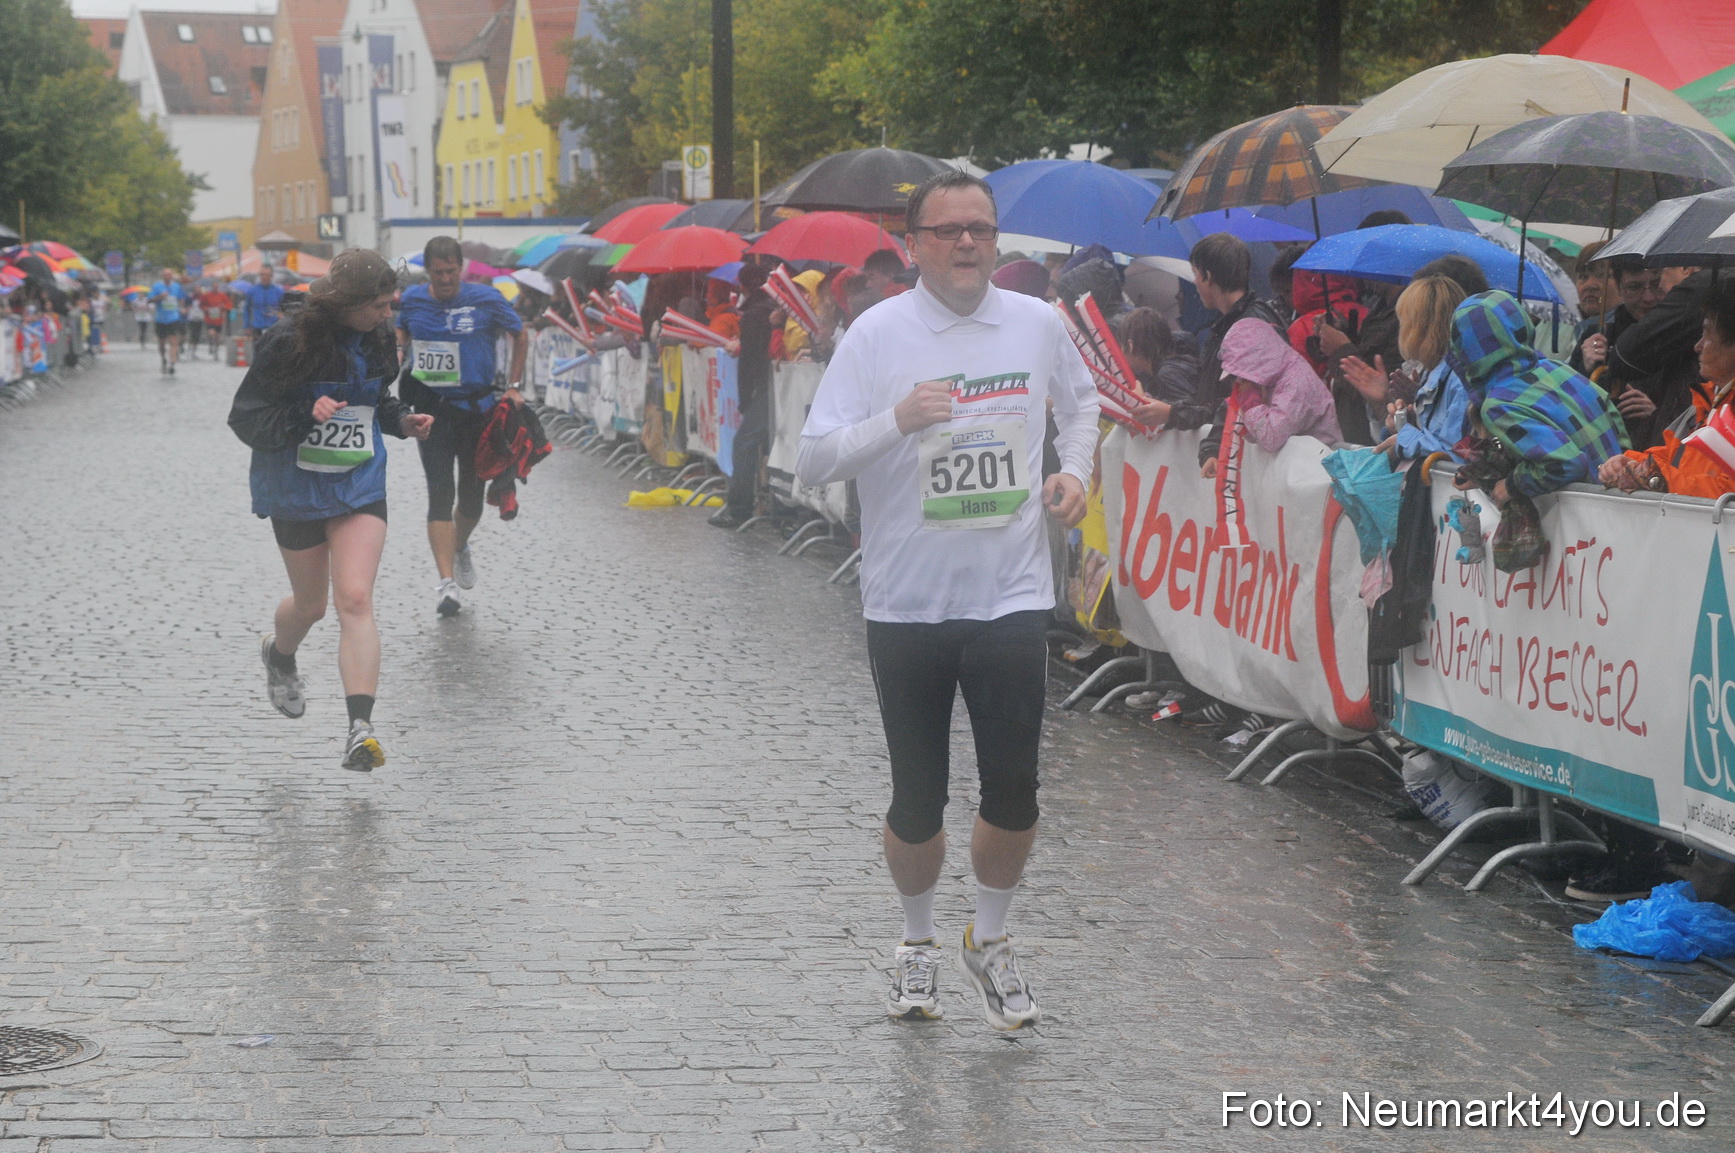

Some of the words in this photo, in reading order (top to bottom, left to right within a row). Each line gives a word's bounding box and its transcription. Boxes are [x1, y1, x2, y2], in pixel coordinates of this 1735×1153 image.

[418, 352, 455, 370] 5073
[964, 375, 1026, 398] ITALIA
[307, 423, 365, 449] 5225
[952, 430, 994, 444] BOCK
[931, 449, 1016, 494] 5201
[961, 500, 997, 514] Hans
[1517, 636, 1647, 737] BESSER.
